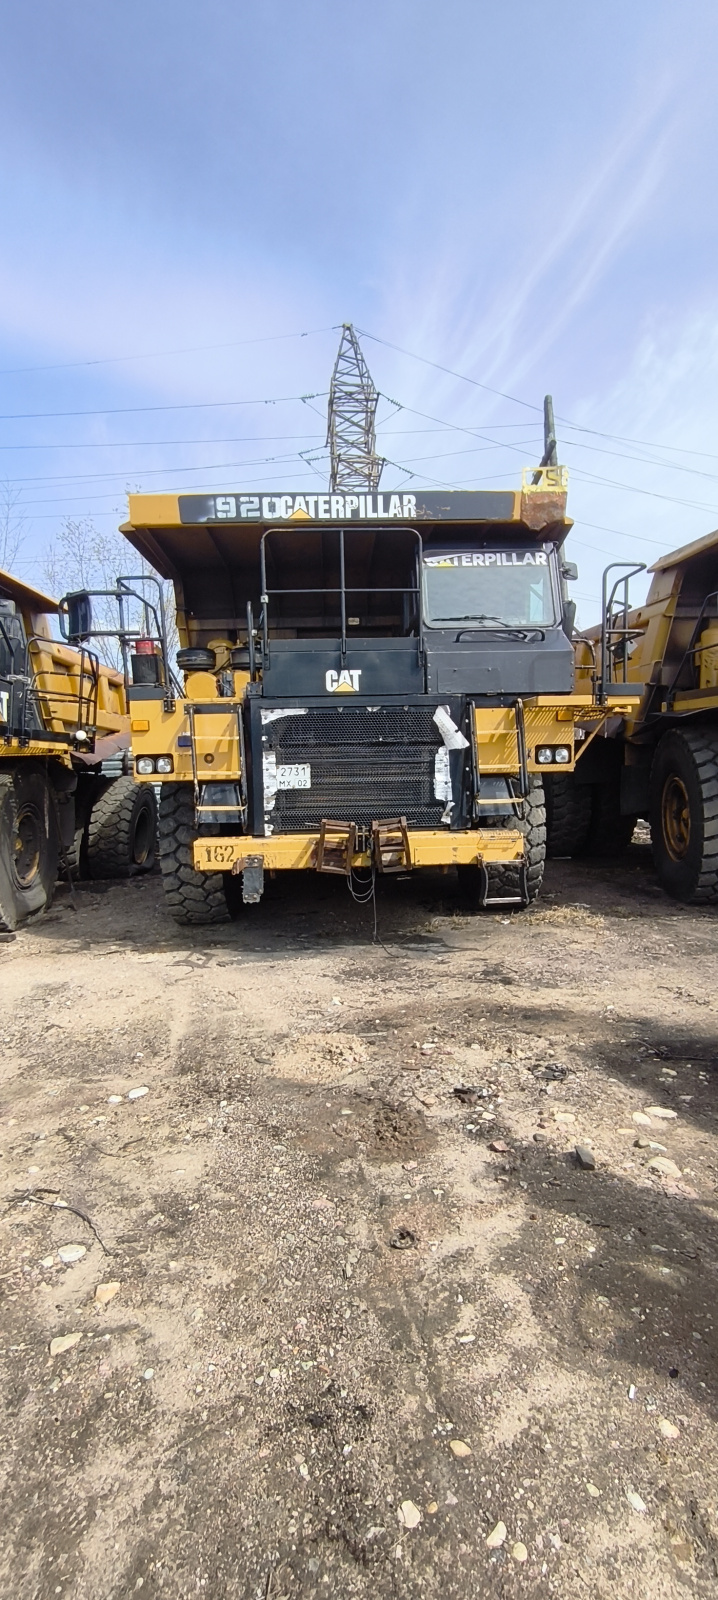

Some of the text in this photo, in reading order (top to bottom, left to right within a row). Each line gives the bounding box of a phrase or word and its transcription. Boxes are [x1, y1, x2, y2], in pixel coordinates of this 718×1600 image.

[280, 494, 417, 519] CATERPILLAR
[325, 669, 362, 692] CAT
[280, 766, 306, 777] 2731
[297, 779, 308, 787] 02
[205, 845, 235, 863] 162
